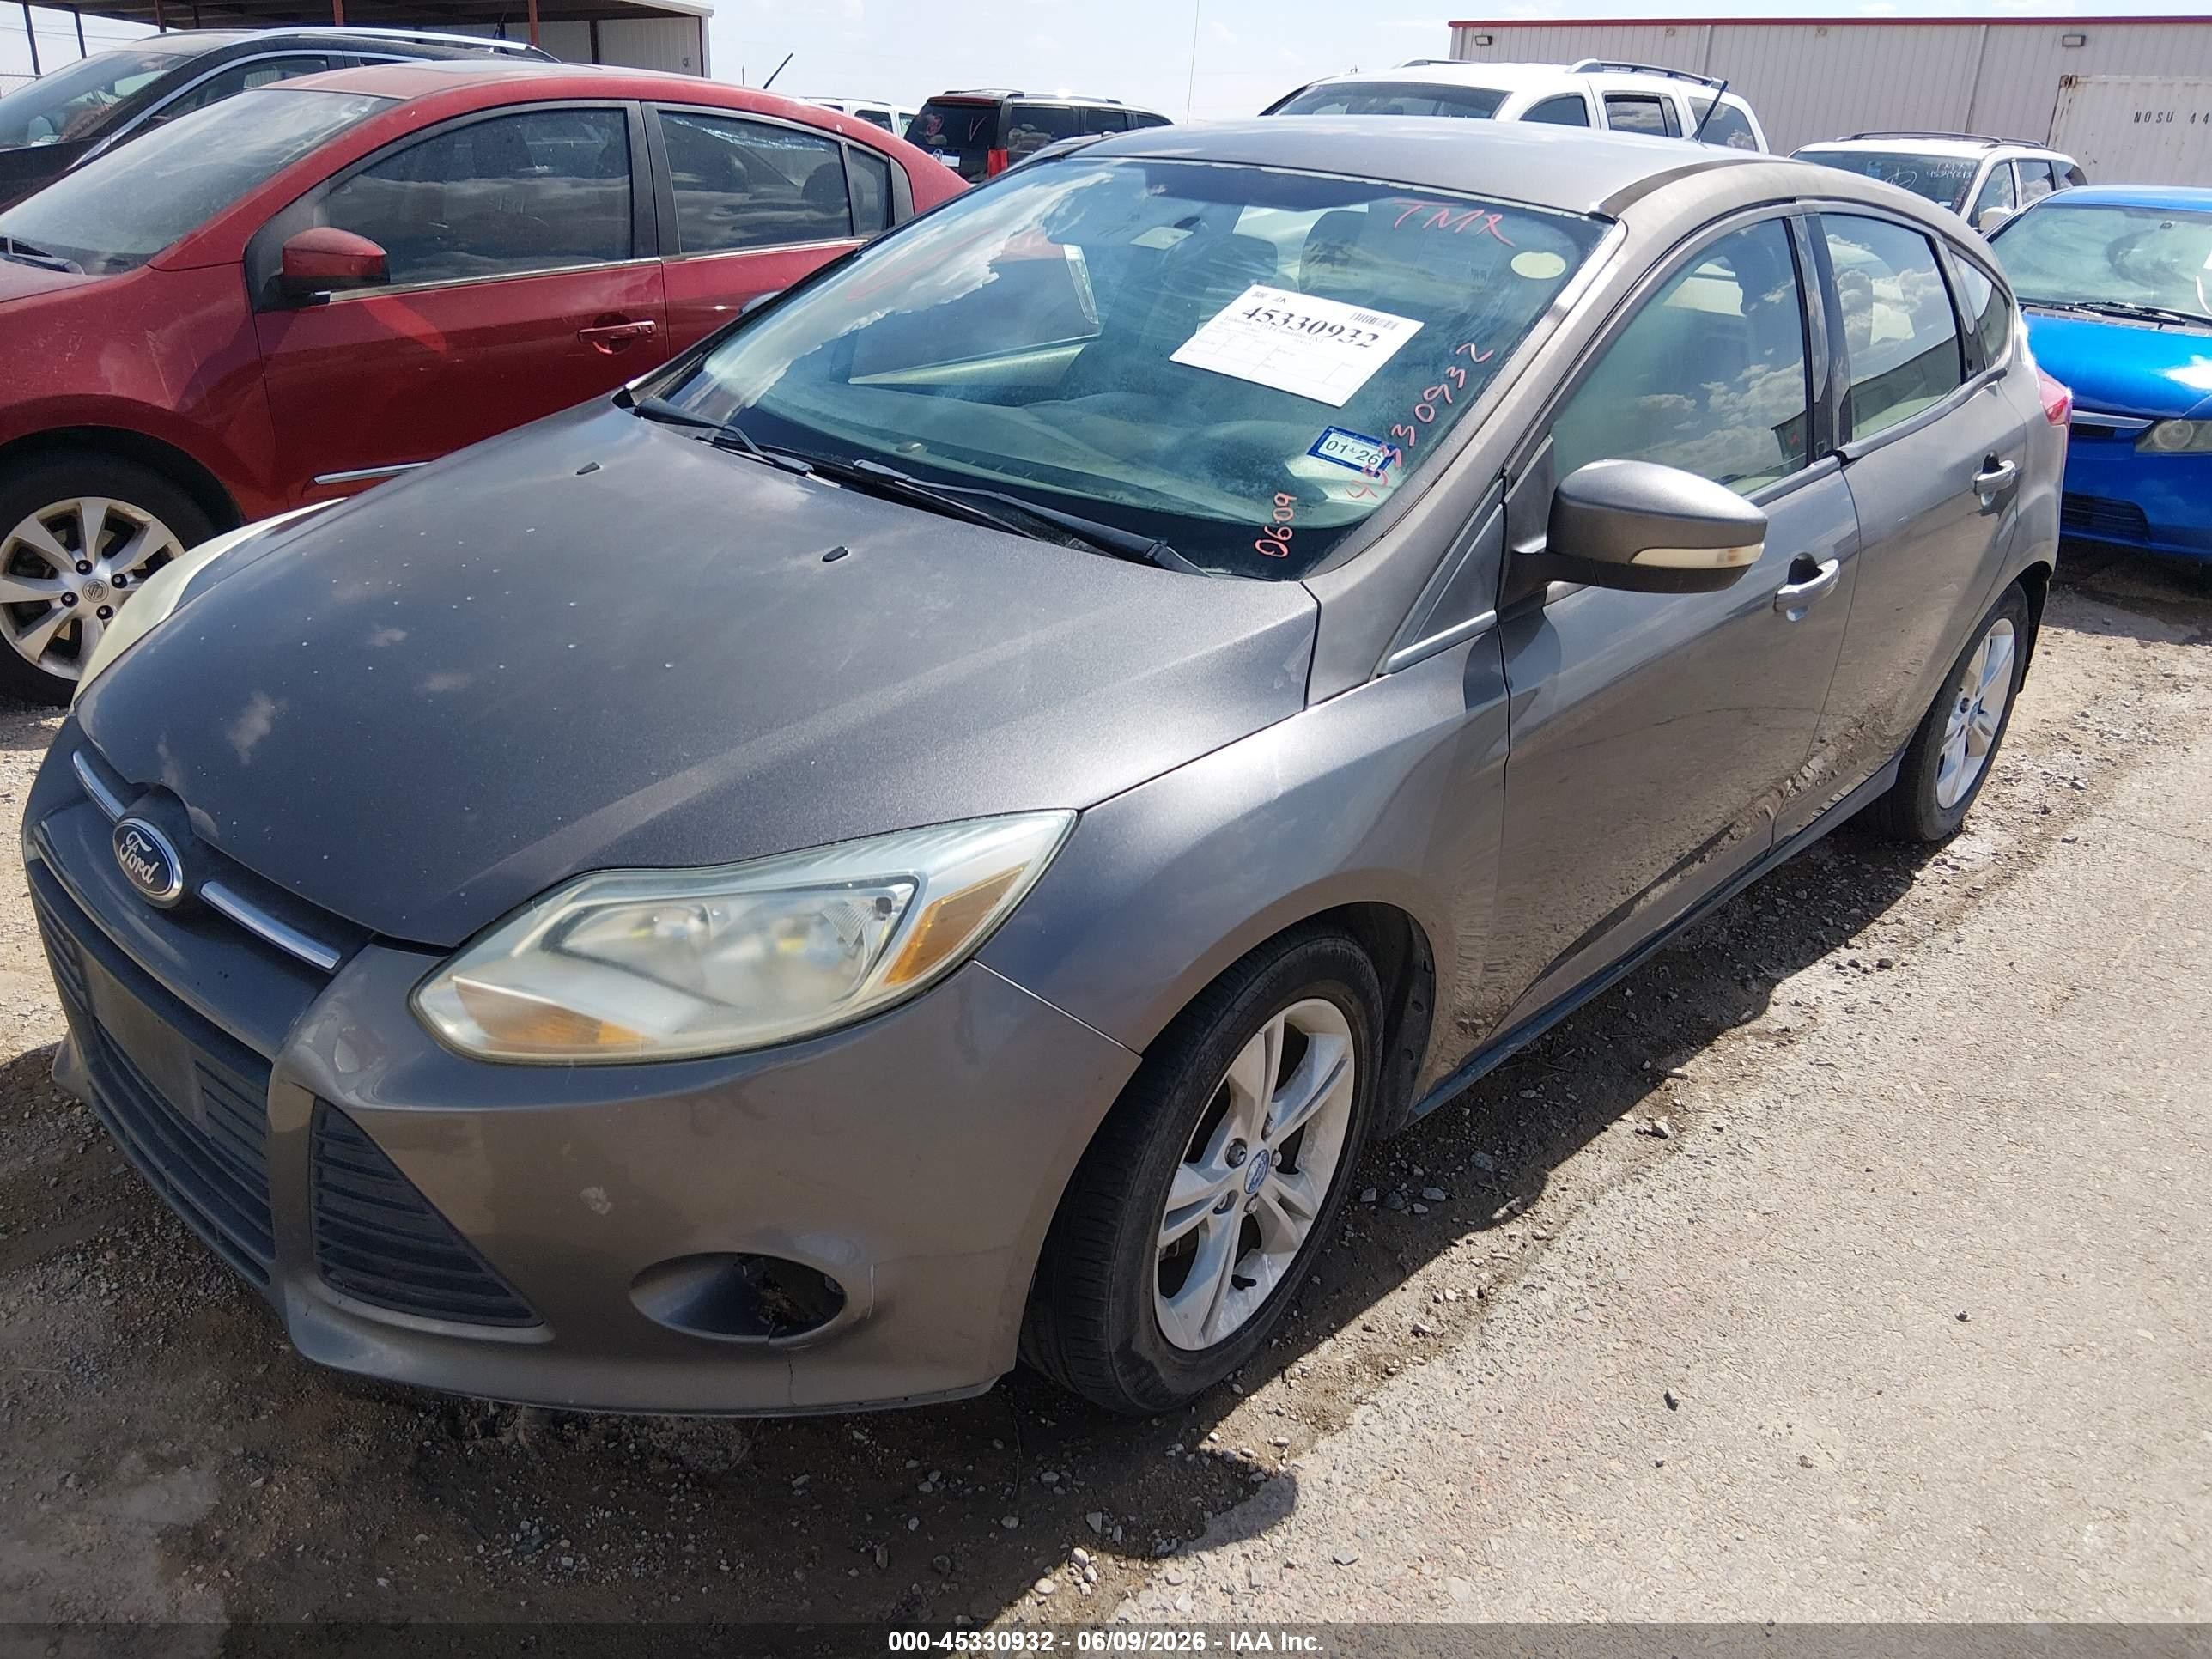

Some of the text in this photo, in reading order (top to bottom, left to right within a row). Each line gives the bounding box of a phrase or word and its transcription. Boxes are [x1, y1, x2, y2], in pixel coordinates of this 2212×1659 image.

[2134, 111, 2174, 124] NOSU
[1242, 306, 1379, 349] 45330932
[1345, 343, 1494, 498] 45330932
[1325, 440, 1381, 465] 01 26
[119, 830, 160, 884] Ford
